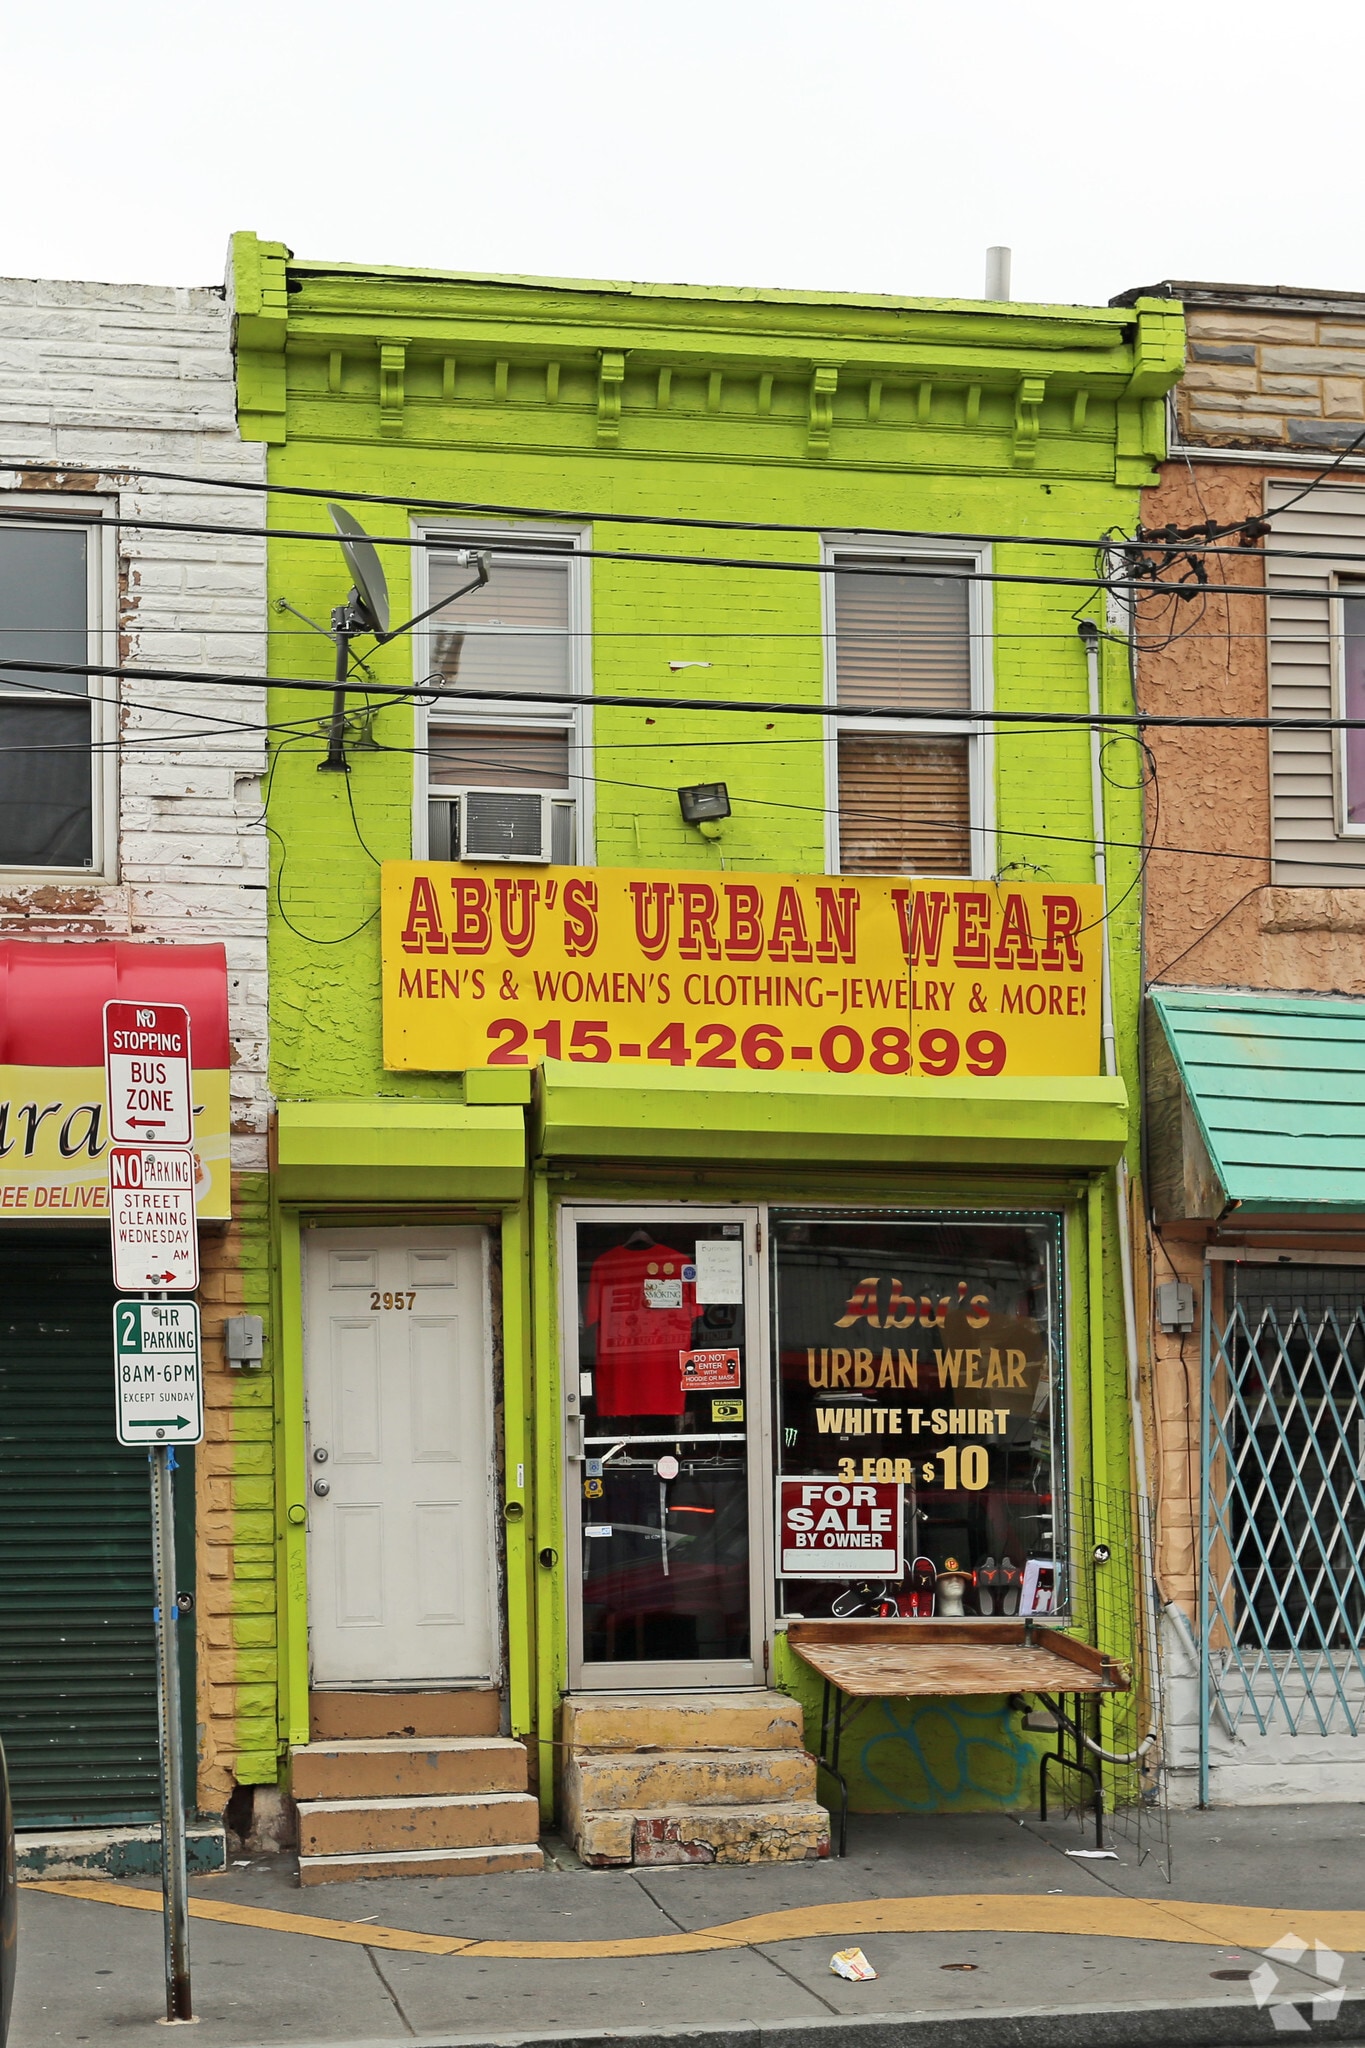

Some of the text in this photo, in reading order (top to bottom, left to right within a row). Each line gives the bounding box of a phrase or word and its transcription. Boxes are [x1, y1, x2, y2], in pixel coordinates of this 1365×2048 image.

[401, 877, 1083, 972] ABU'S URBAN WEAR
[399, 968, 486, 1000] MEN'S
[500, 970, 519, 1000] &
[533, 971, 670, 1004] WOMEN'S
[968, 982, 987, 1014] &
[1001, 984, 1087, 1016] MORE!
[136, 1009, 156, 1028] NO
[113, 1030, 182, 1052] STOPPING
[486, 1018, 1007, 1077] 215-426-0899
[131, 1062, 167, 1084] BUS
[126, 1089, 174, 1112] ZONE
[112, 1154, 189, 1187] NO PARKING
[124, 1194, 180, 1209] STREET
[119, 1211, 187, 1226] CLEANING
[119, 1229, 189, 1244] WEDNESDAY
[173, 1250, 189, 1260] AM
[370, 1291, 416, 1311] 2957
[833, 1277, 991, 1329] Abu's
[121, 1309, 179, 1346] 2 HR
[143, 1331, 194, 1348] PARKING
[122, 1365, 195, 1382] 8AM-6PM
[806, 1347, 1028, 1389] URBAN WEAR
[123, 1392, 194, 1403] EXCEPT SUNDAY
[816, 1408, 1010, 1435] WHITE T-SHIRT
[838, 1457, 855, 1484] 3
[863, 1457, 911, 1484] FOR
[802, 1485, 877, 1507] FOR
[786, 1507, 892, 1532] SALE
[795, 1533, 883, 1548] BY OWNER
